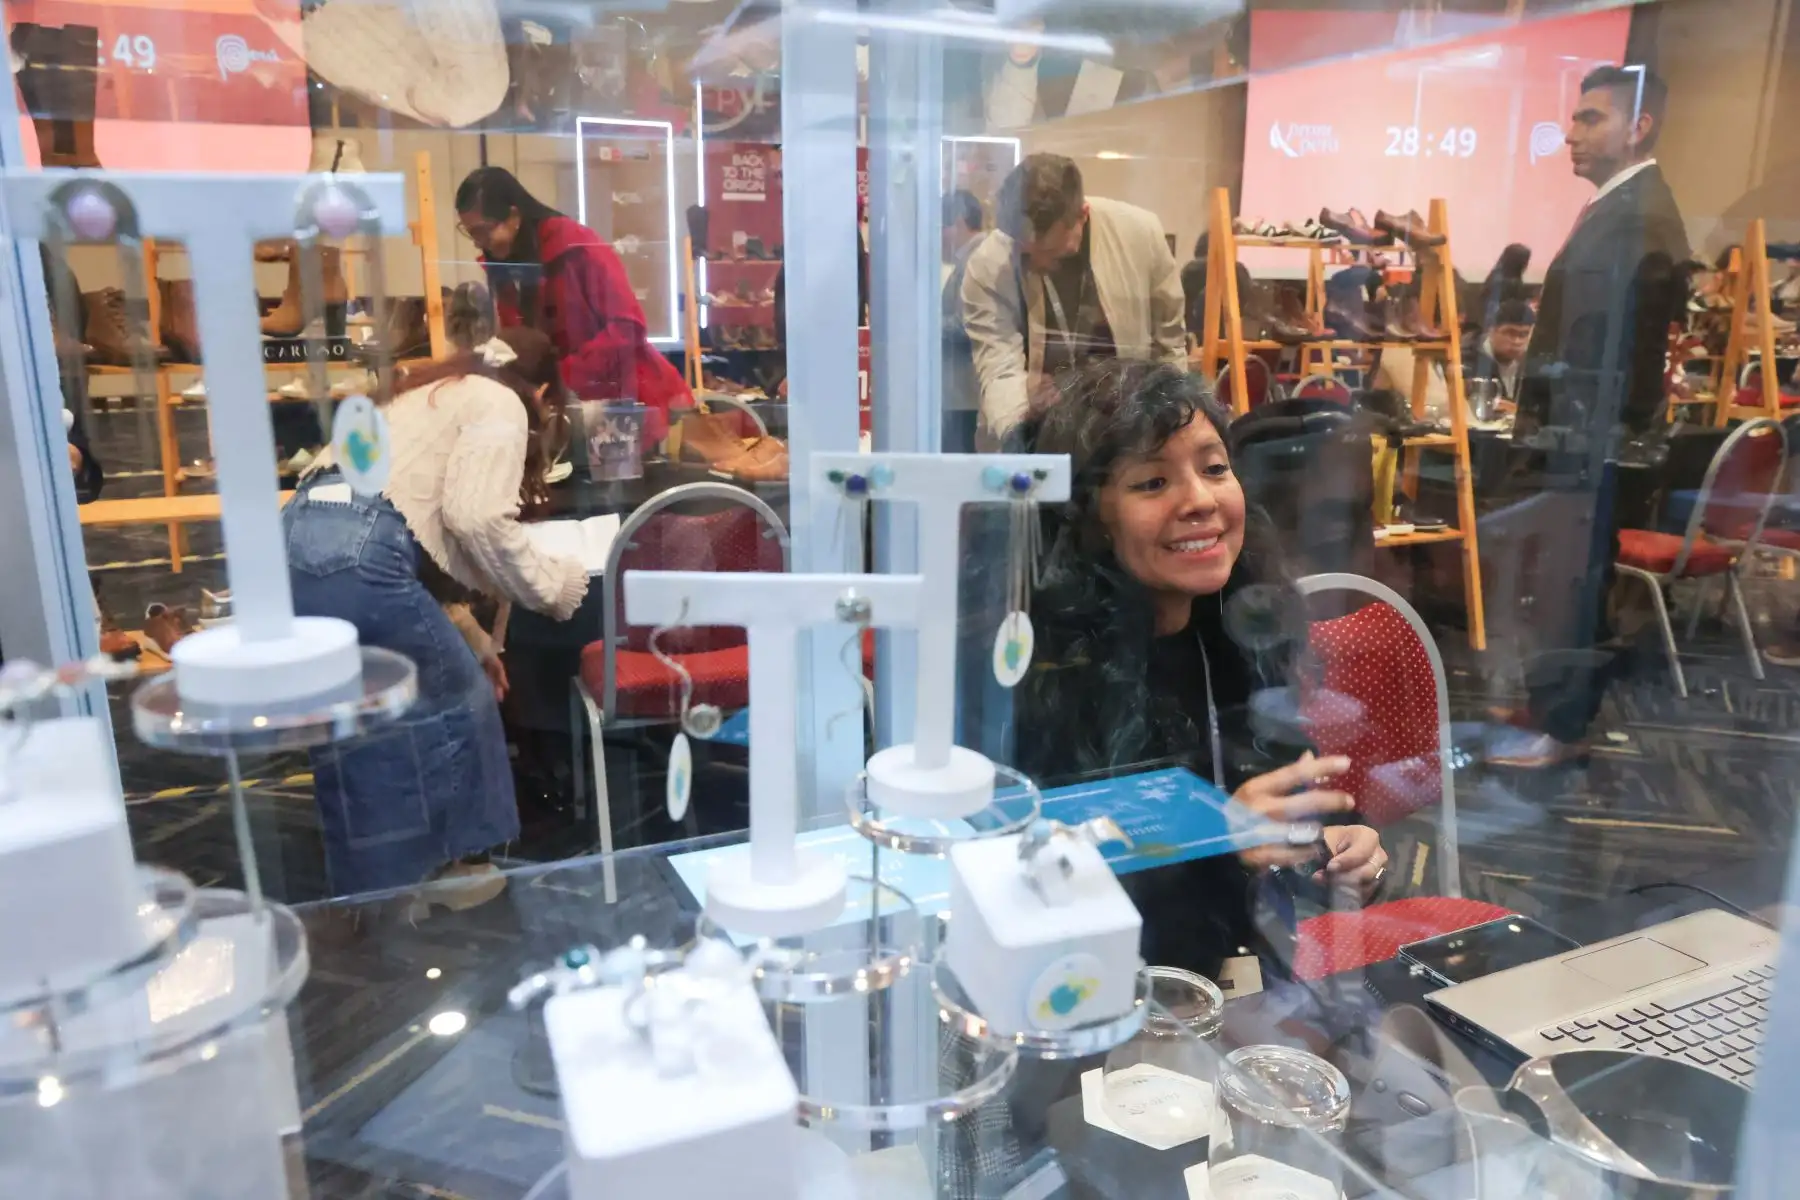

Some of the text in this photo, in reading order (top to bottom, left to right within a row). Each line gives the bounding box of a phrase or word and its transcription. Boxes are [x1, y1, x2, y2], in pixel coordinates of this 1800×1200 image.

[1384, 126, 1477, 157] 28:49
[732, 153, 765, 166] BACK
[722, 166, 765, 179] TO THE
[723, 179, 765, 192] ORIGIN
